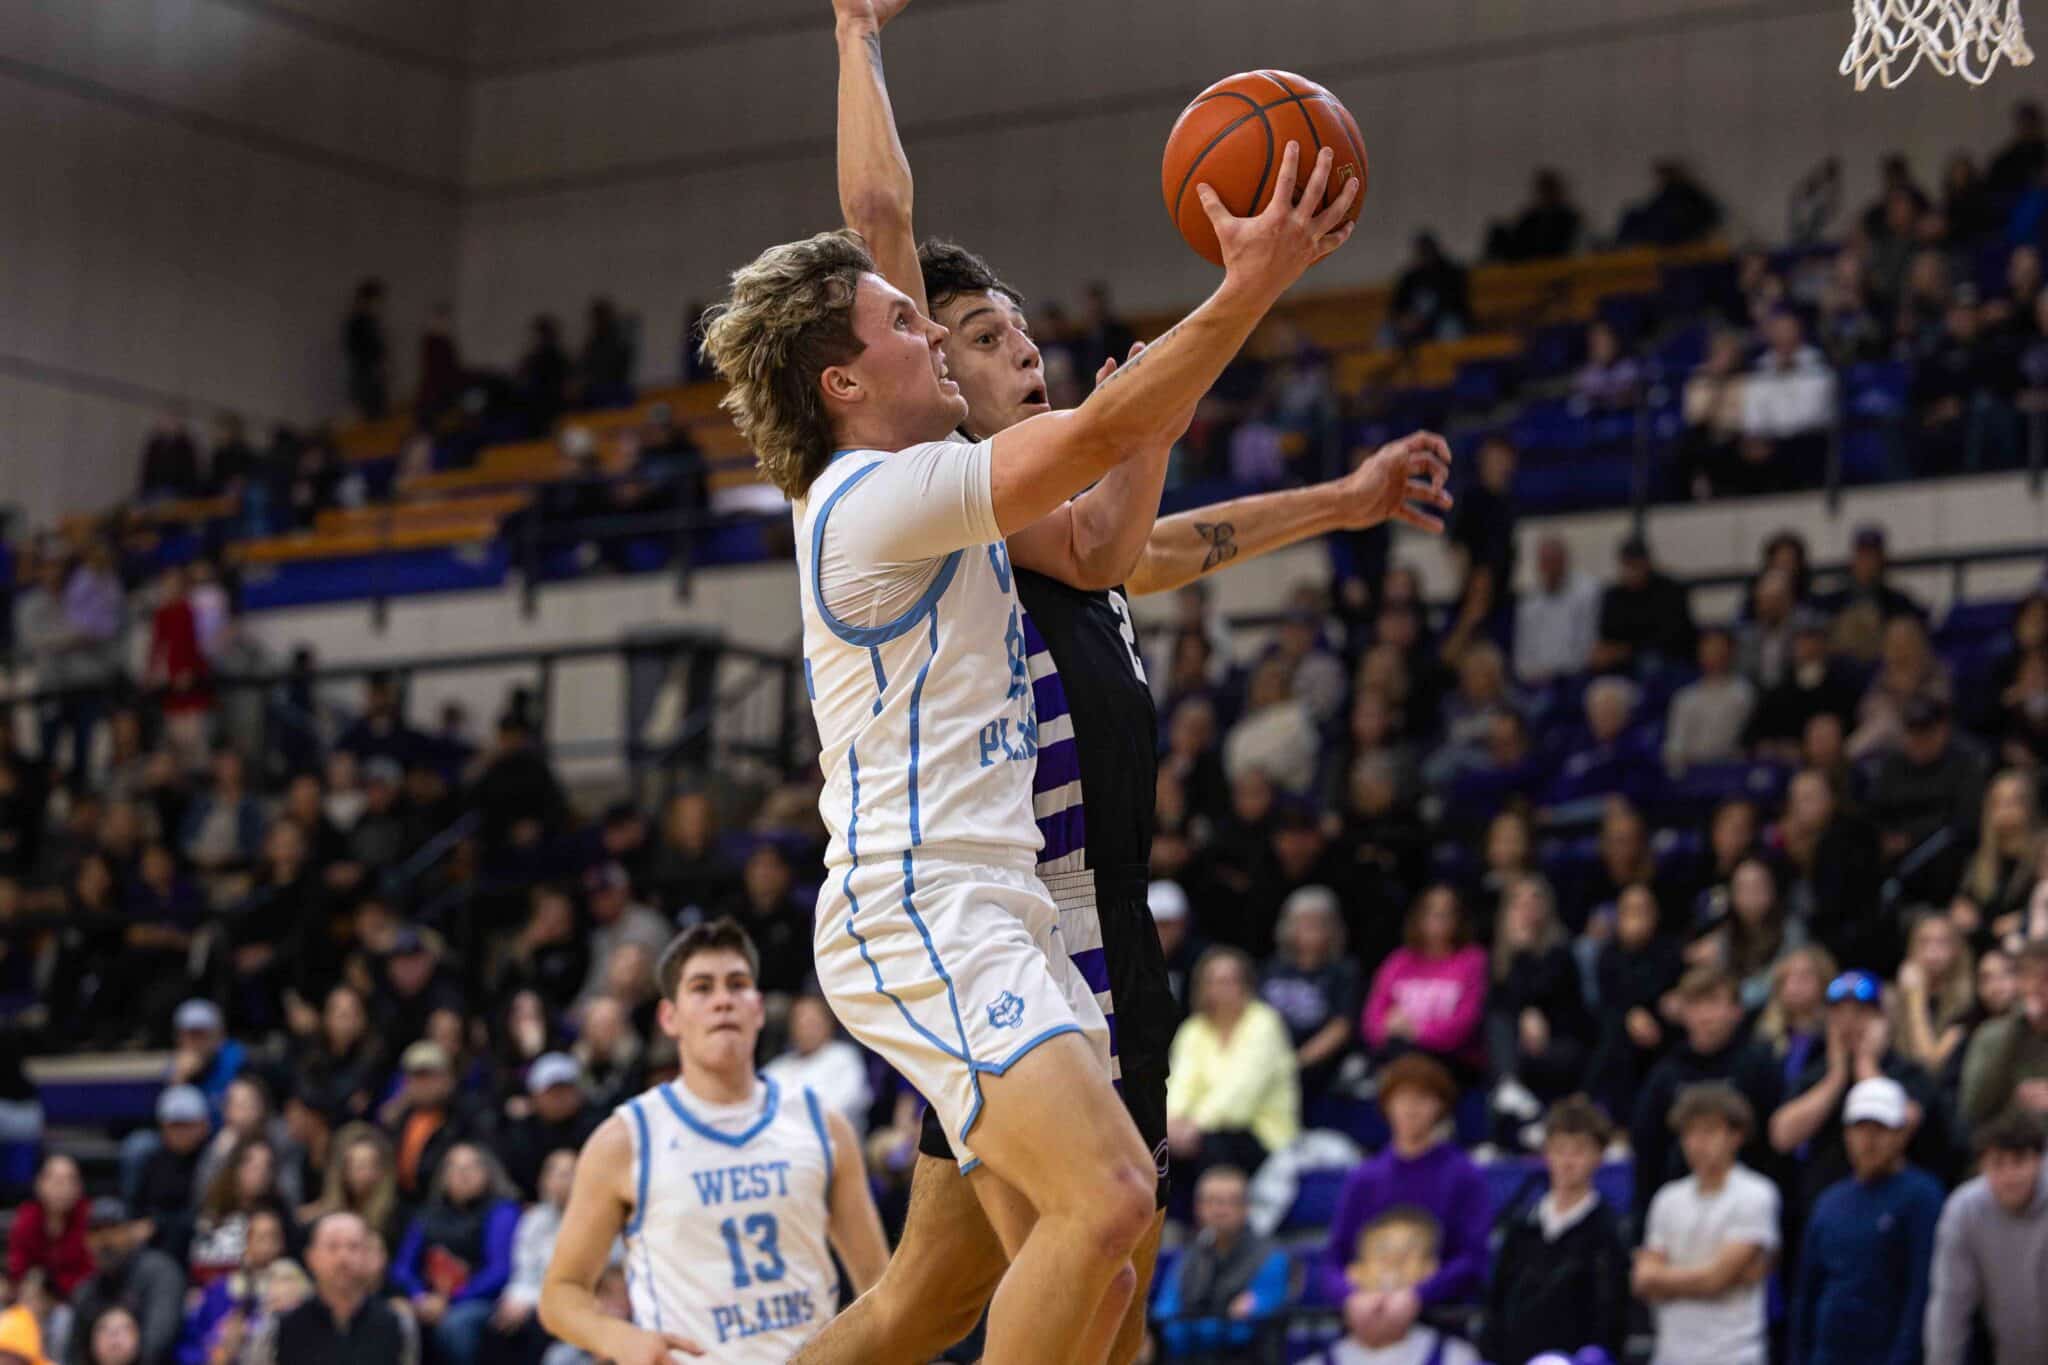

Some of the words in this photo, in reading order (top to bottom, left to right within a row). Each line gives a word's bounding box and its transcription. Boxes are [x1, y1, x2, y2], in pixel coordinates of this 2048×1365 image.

[692, 1161, 790, 1206] WEST
[721, 1212, 786, 1288] 13
[712, 1289, 815, 1344] PLAINS
